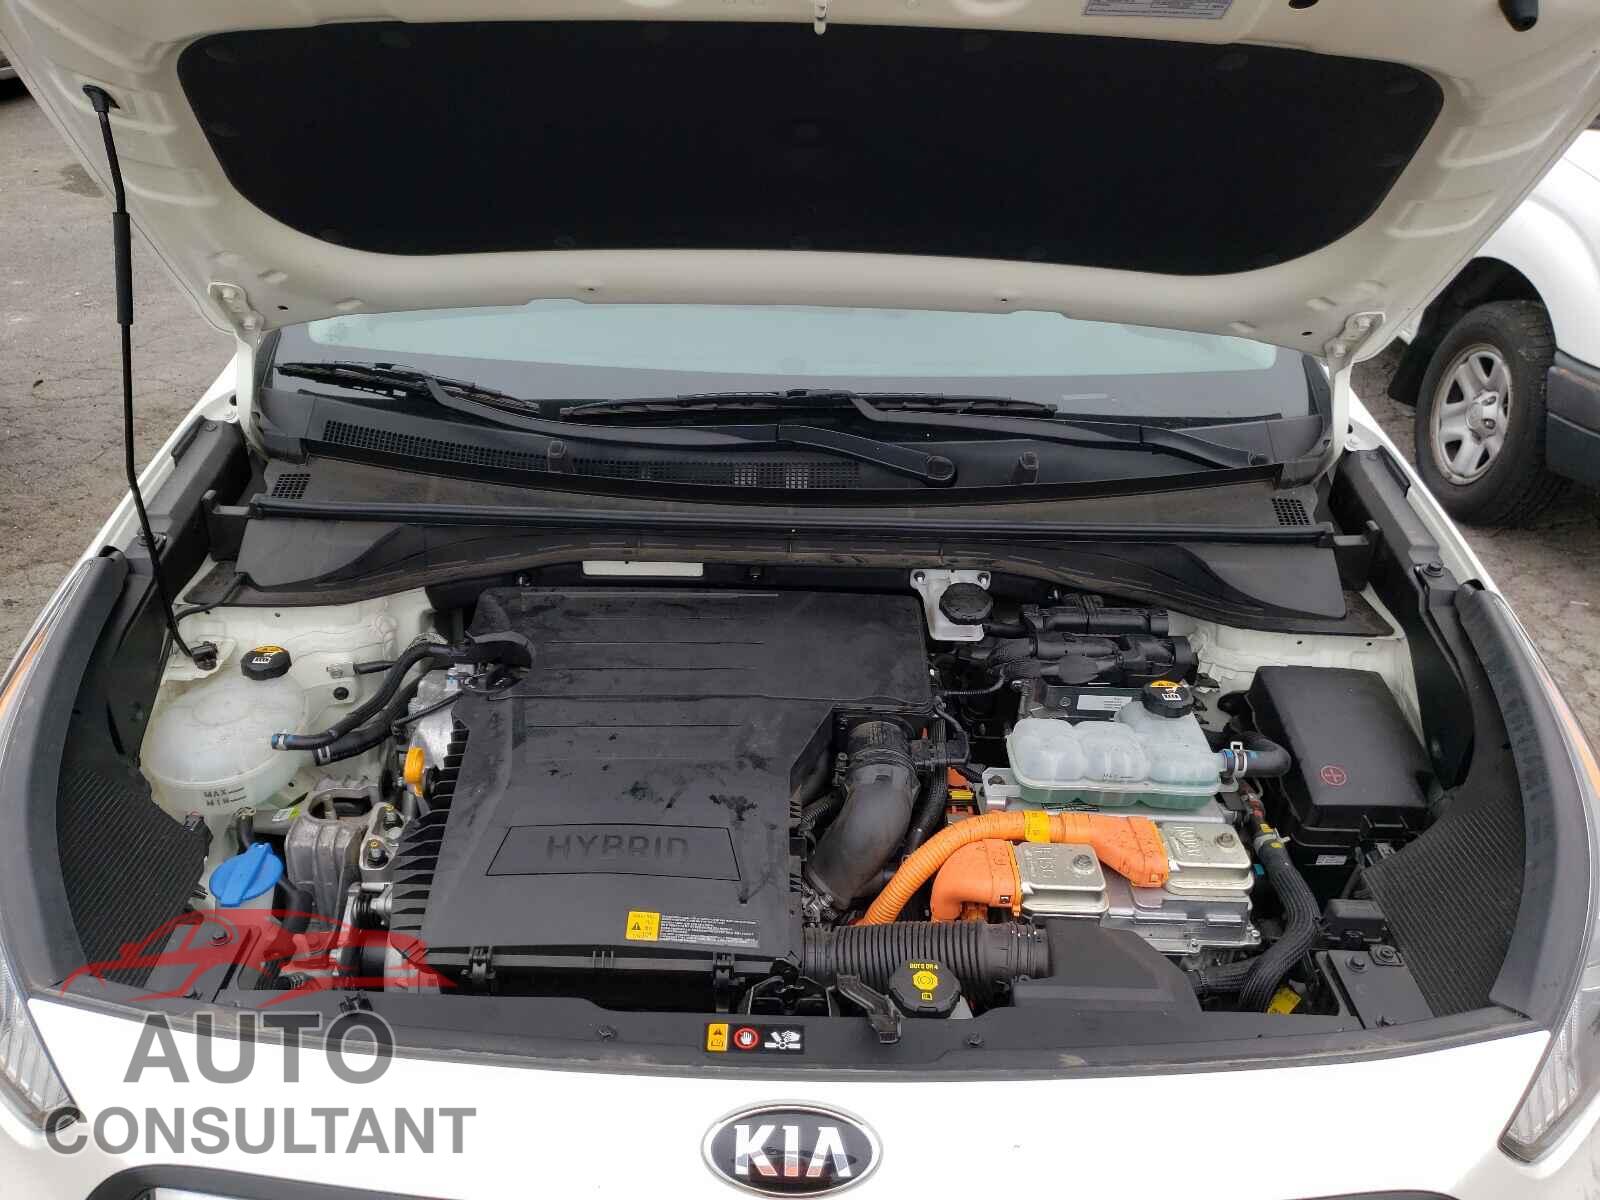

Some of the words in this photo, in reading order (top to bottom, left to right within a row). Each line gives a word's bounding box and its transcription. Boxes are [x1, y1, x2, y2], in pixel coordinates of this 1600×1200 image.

[203, 789, 227, 798] MAX
[545, 834, 690, 861] HYBRID
[734, 1124, 853, 1178] KIA
